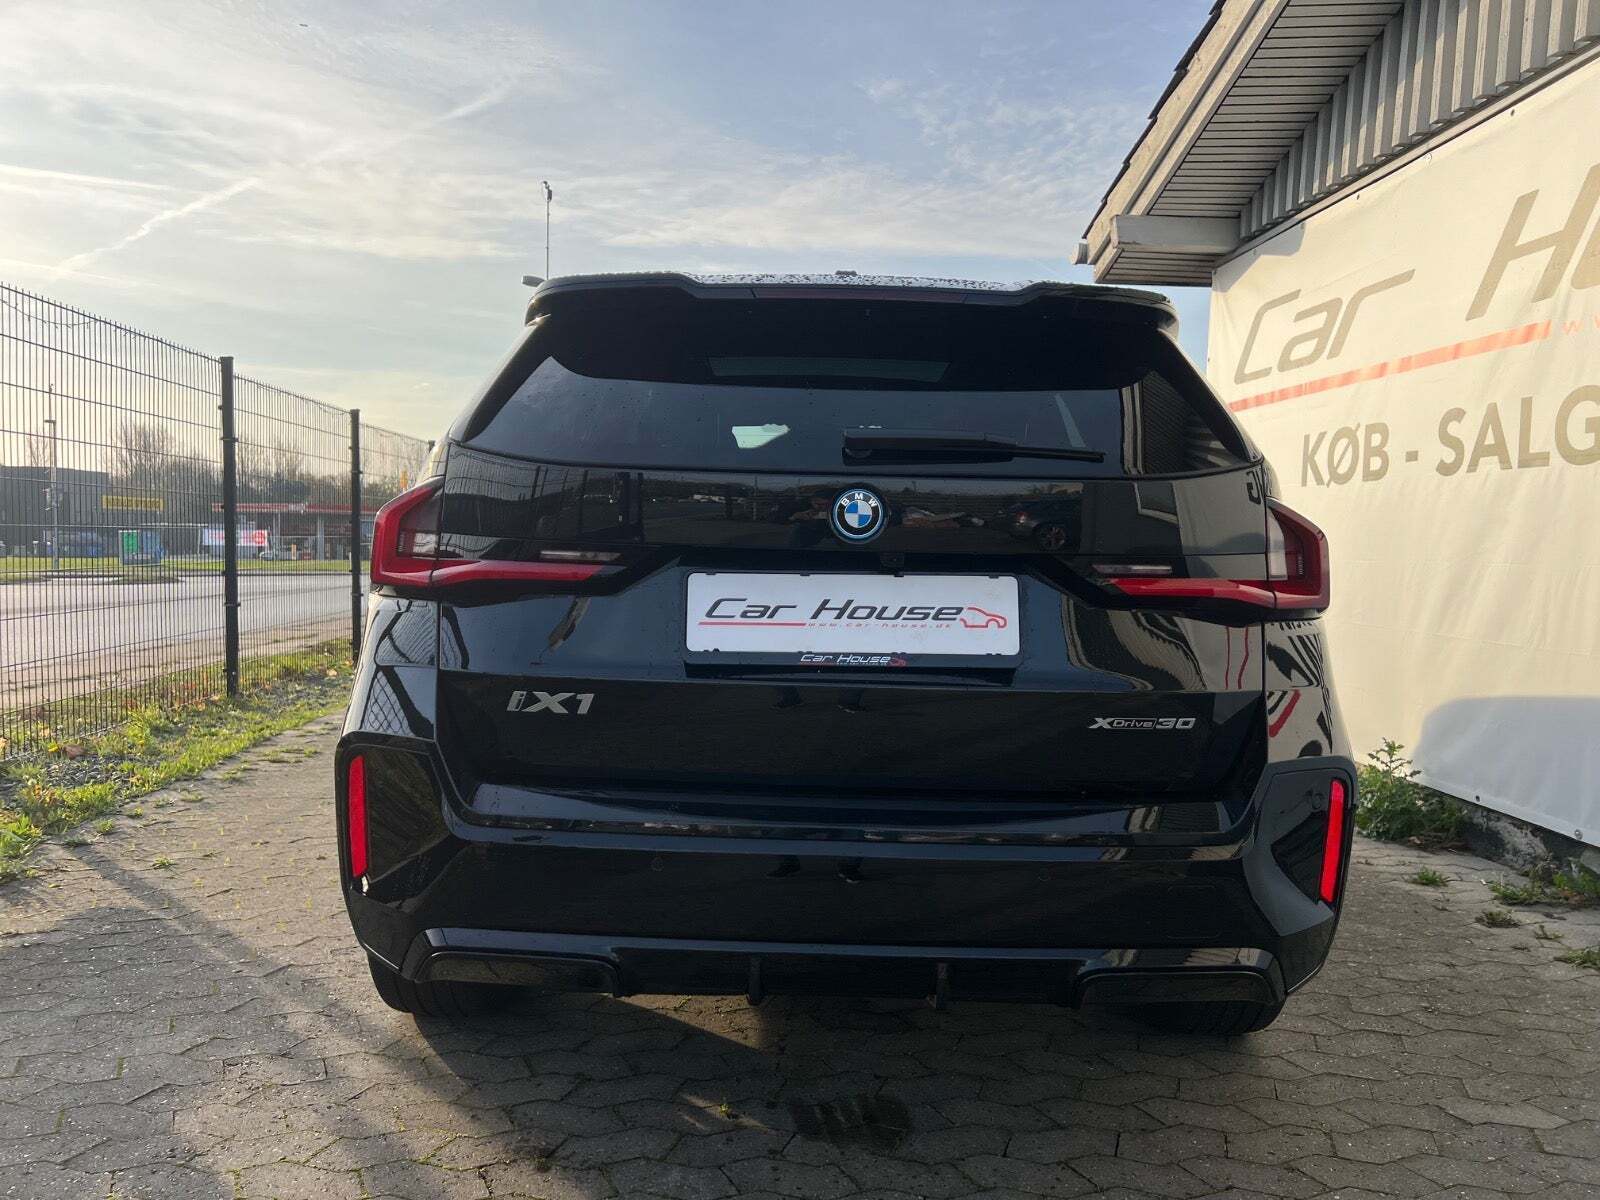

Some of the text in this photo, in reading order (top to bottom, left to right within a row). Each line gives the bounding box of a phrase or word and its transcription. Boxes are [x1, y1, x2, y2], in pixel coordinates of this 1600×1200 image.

[1234, 269, 1416, 385] Car
[1301, 422, 1390, 488] KØB
[1435, 384, 1600, 477] SALG
[840, 492, 878, 507] BMW
[704, 597, 965, 622] Car House
[800, 653, 834, 663] Car
[836, 653, 892, 665] House
